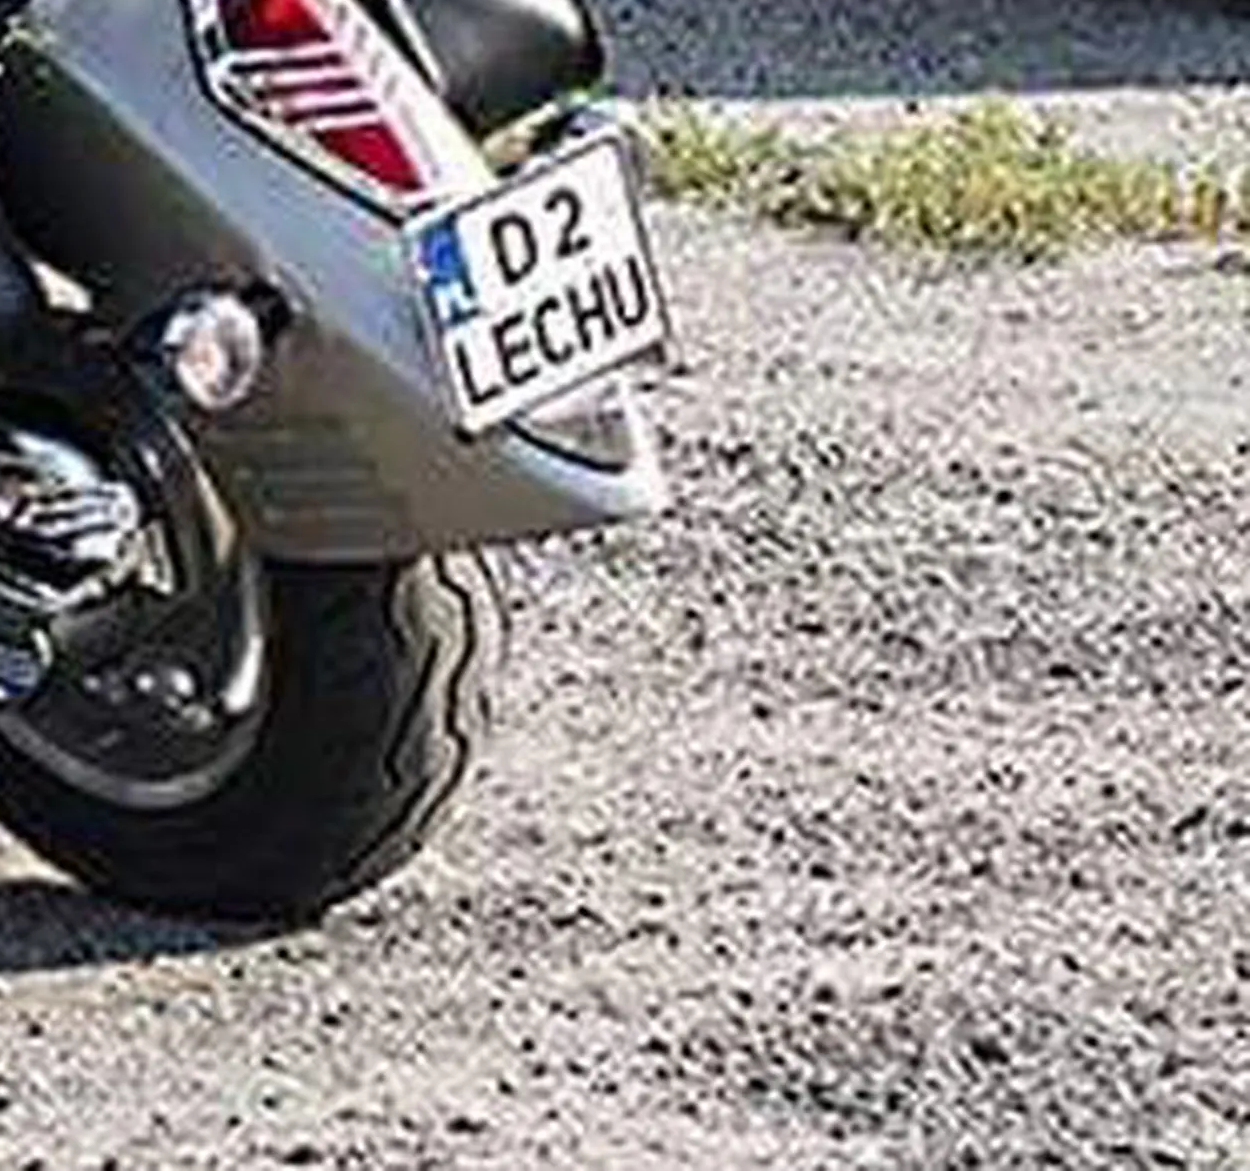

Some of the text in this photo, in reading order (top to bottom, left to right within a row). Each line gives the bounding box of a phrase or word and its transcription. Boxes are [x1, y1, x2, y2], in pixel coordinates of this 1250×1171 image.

[490, 187, 591, 285] D 2
[454, 254, 649, 406] LECHU
